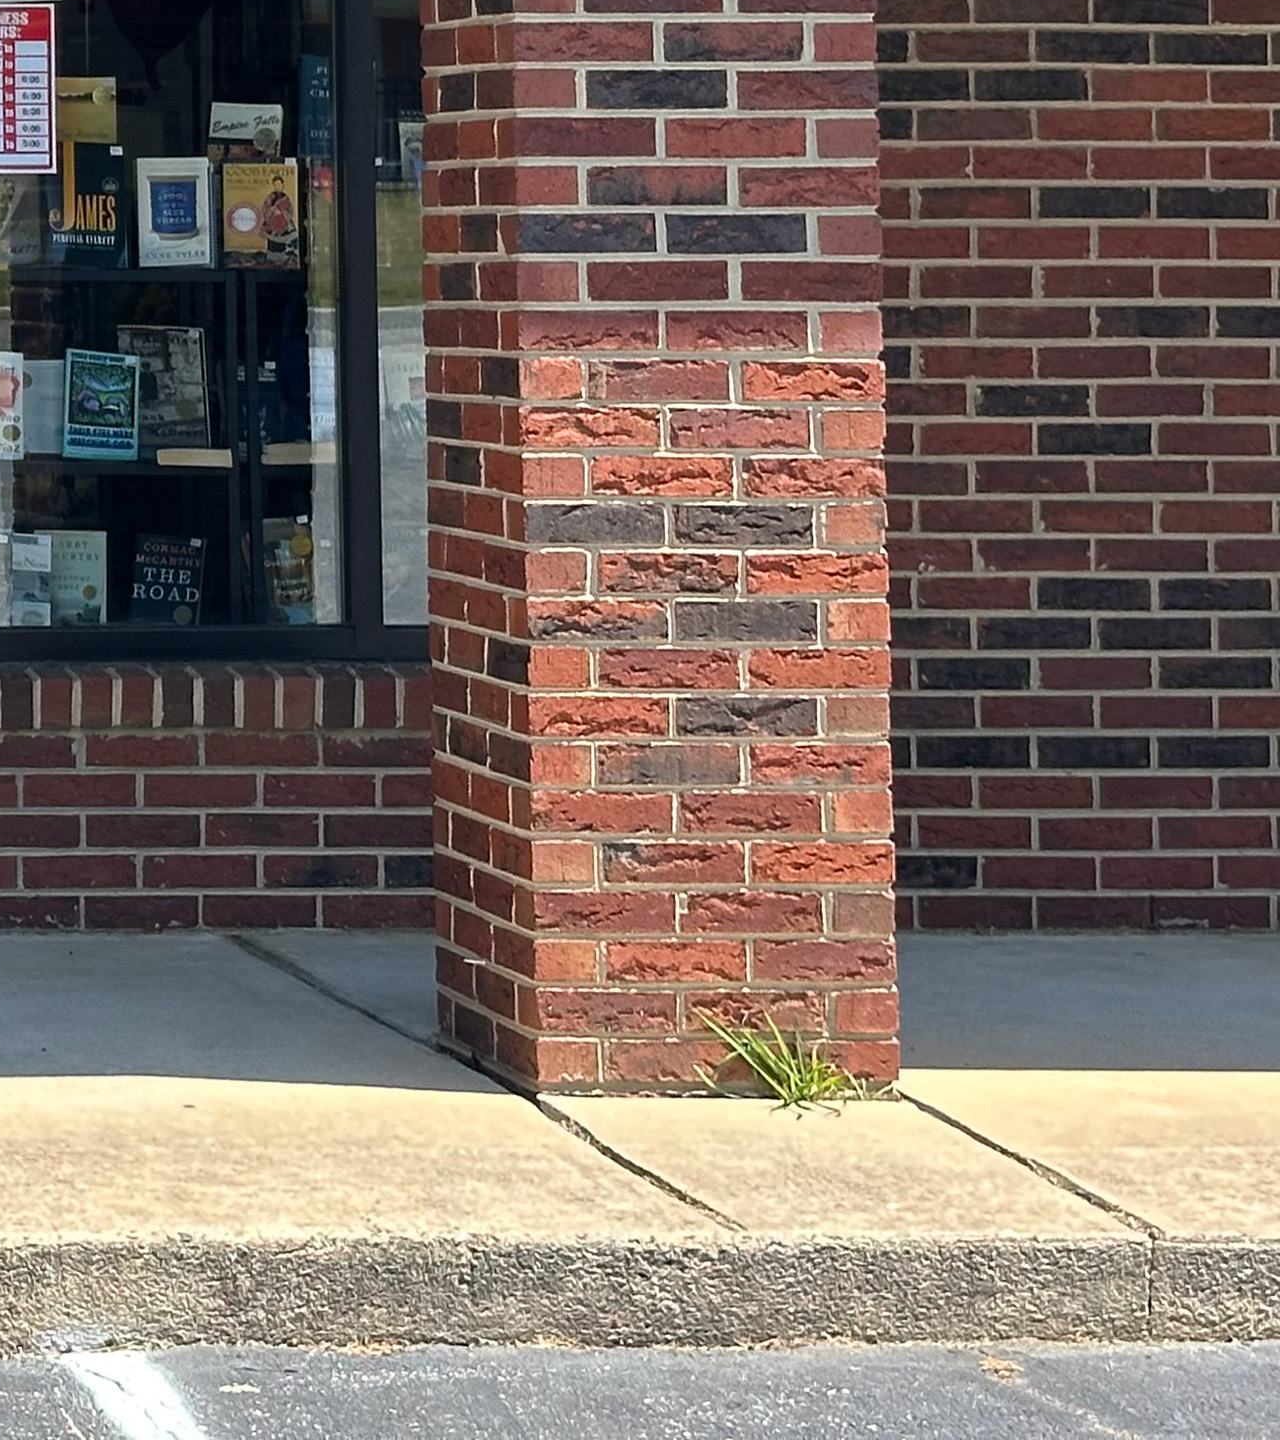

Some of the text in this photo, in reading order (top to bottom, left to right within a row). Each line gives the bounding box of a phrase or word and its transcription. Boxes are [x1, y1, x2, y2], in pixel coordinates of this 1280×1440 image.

[212, 115, 281, 134] Empire Falls
[49, 142, 116, 232] JAMES
[143, 541, 196, 554] CORMAC
[143, 567, 191, 584] THE
[132, 583, 200, 603] ROAD
